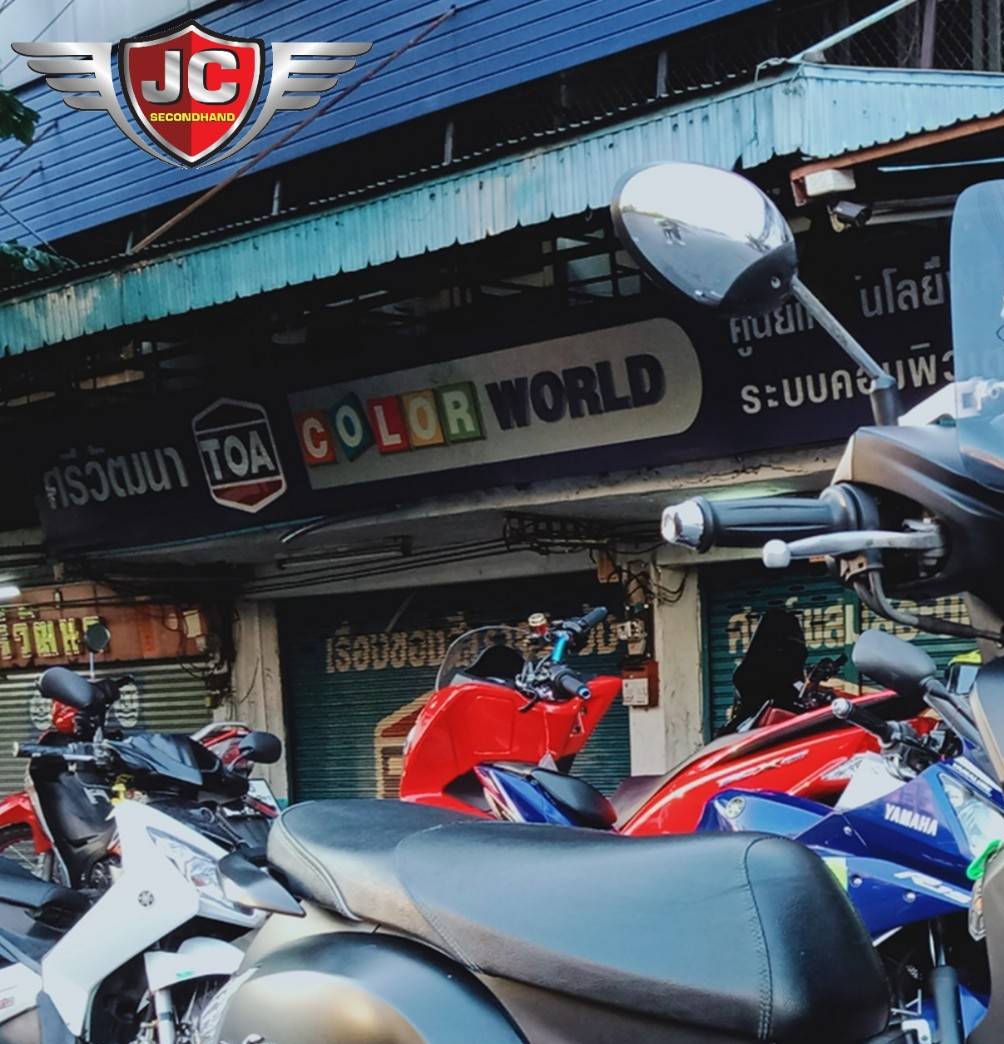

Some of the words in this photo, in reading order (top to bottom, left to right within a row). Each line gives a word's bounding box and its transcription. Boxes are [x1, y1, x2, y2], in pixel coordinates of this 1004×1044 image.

[303, 385, 479, 461] COLOR
[485, 354, 666, 430] WORLD
[199, 431, 276, 481] TOA
[884, 803, 939, 837] YAMAHA
